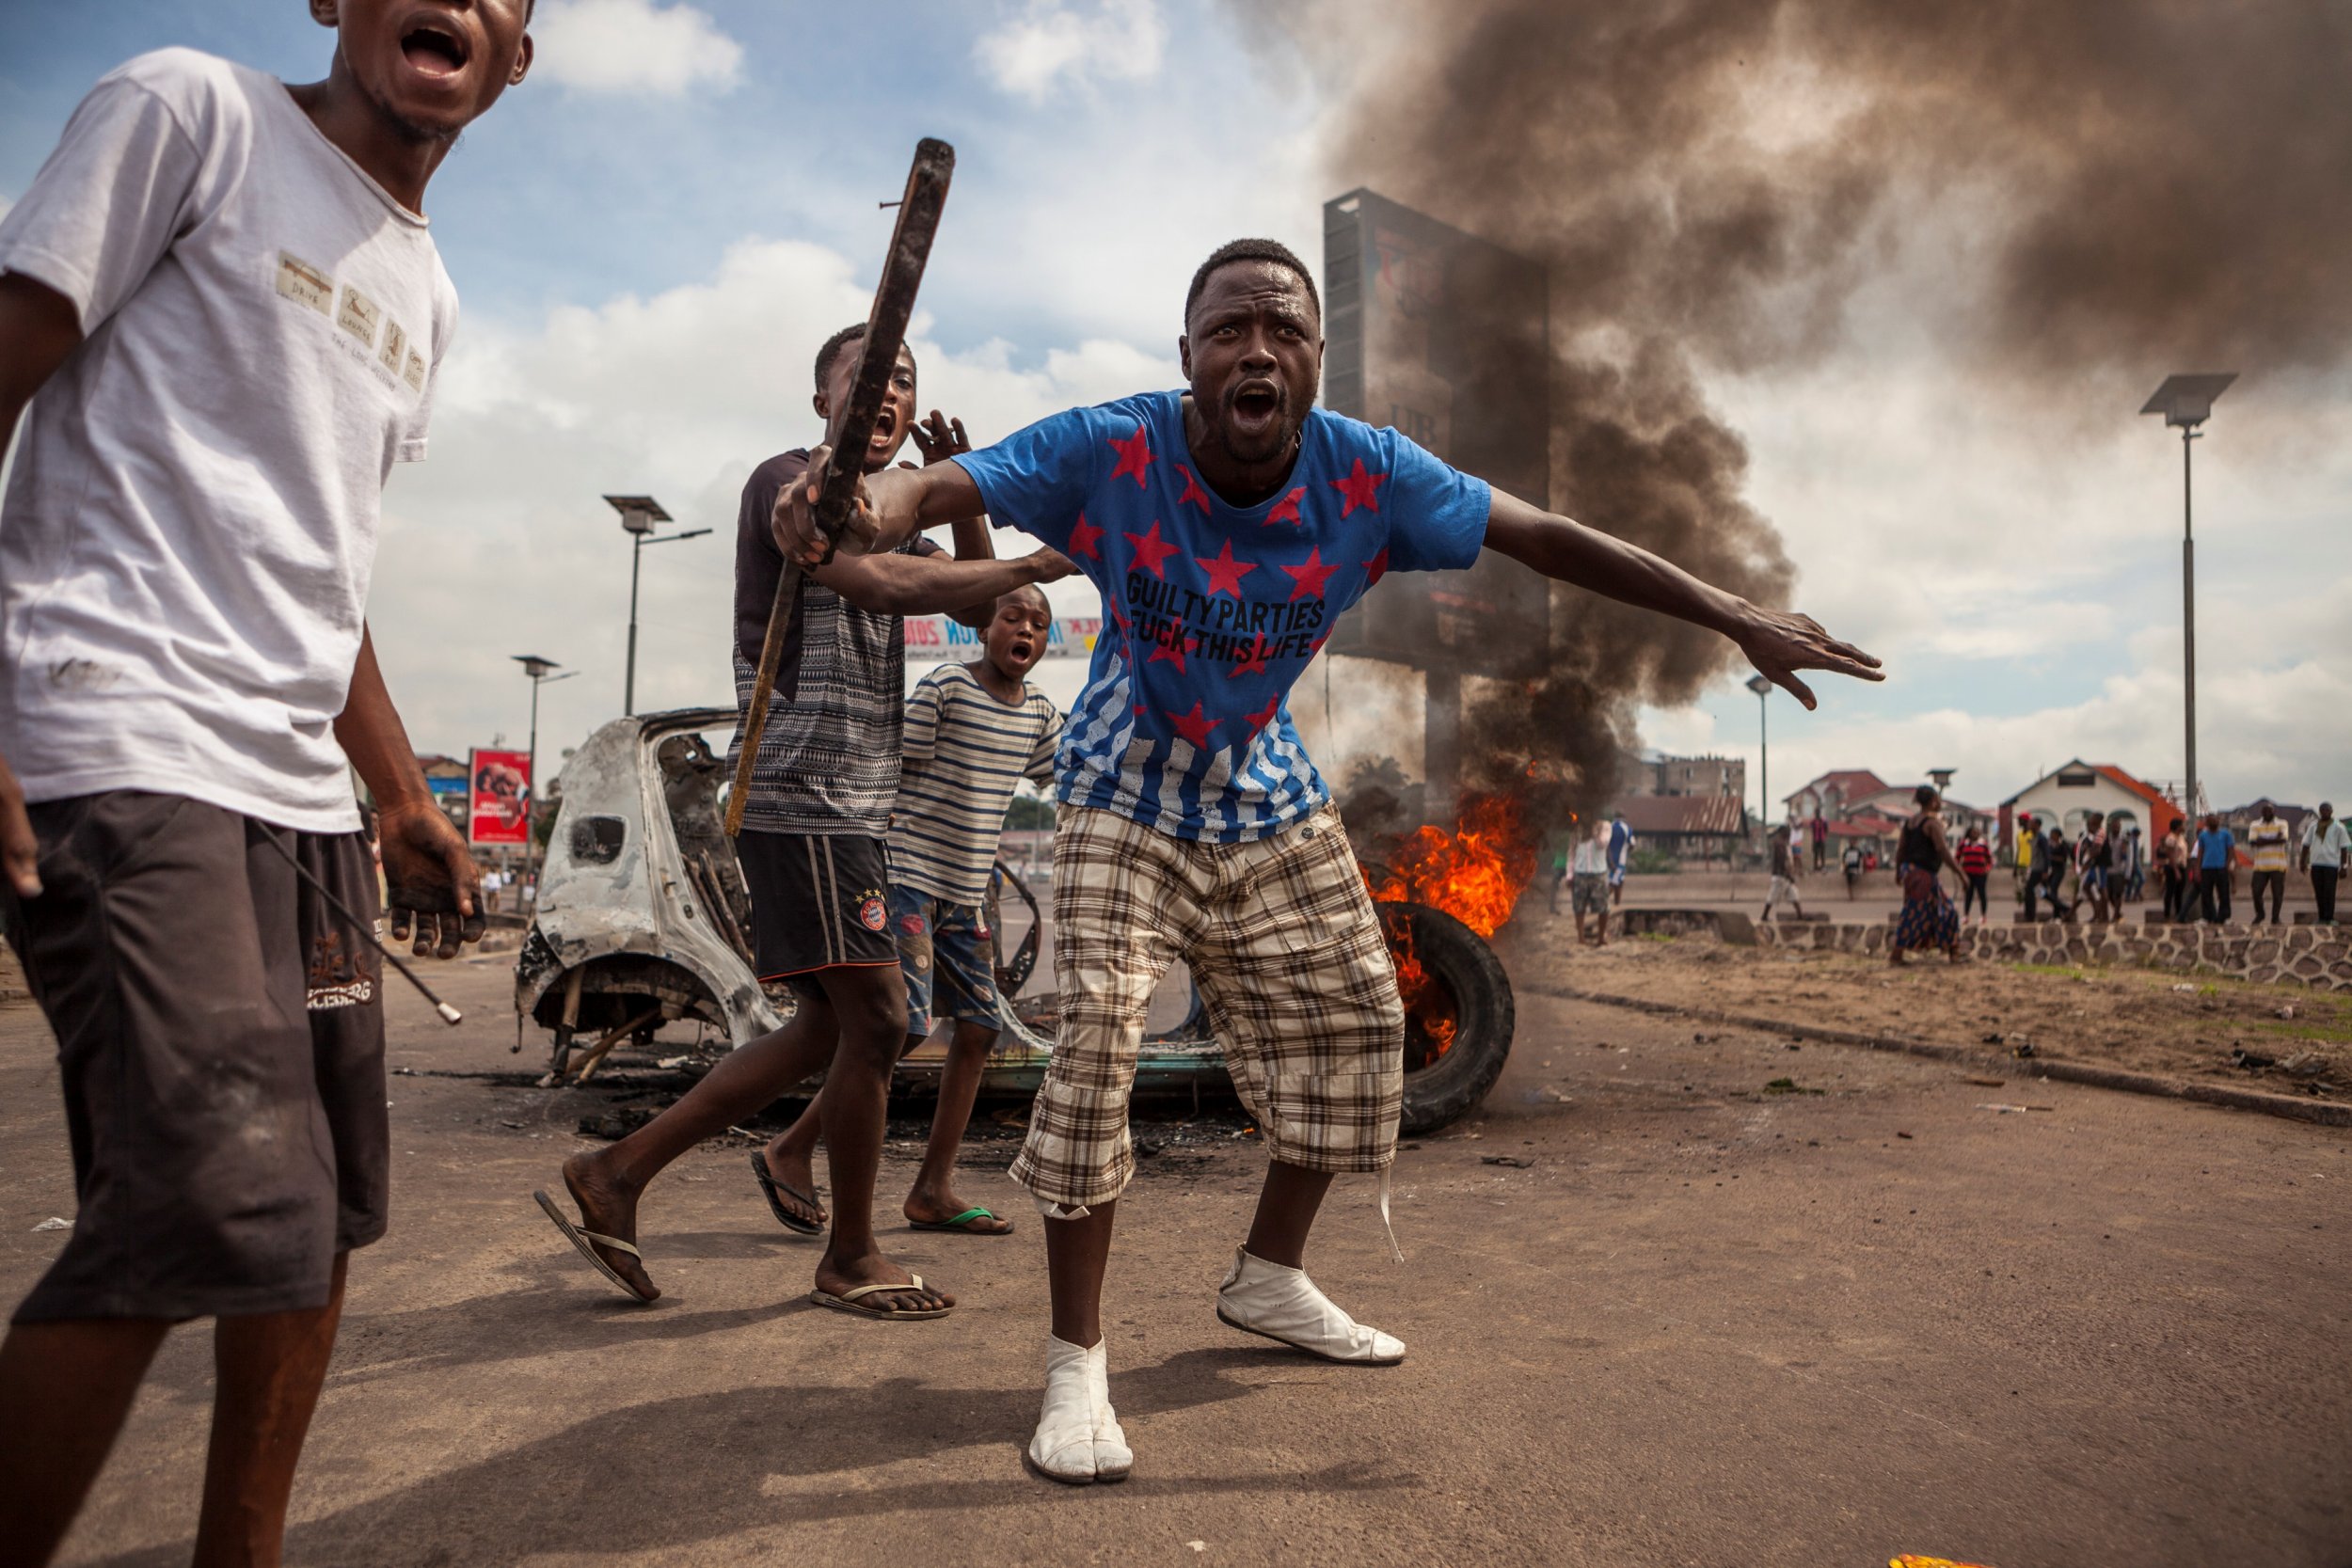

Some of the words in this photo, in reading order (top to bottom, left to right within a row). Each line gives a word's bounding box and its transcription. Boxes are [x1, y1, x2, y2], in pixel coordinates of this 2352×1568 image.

[1126, 571, 1216, 626] GUILTY
[1216, 598, 1326, 634] PARTIES
[1130, 609, 1193, 656] FUCK
[1194, 628, 1255, 664] THIS
[1256, 632, 1314, 662] LIFE
